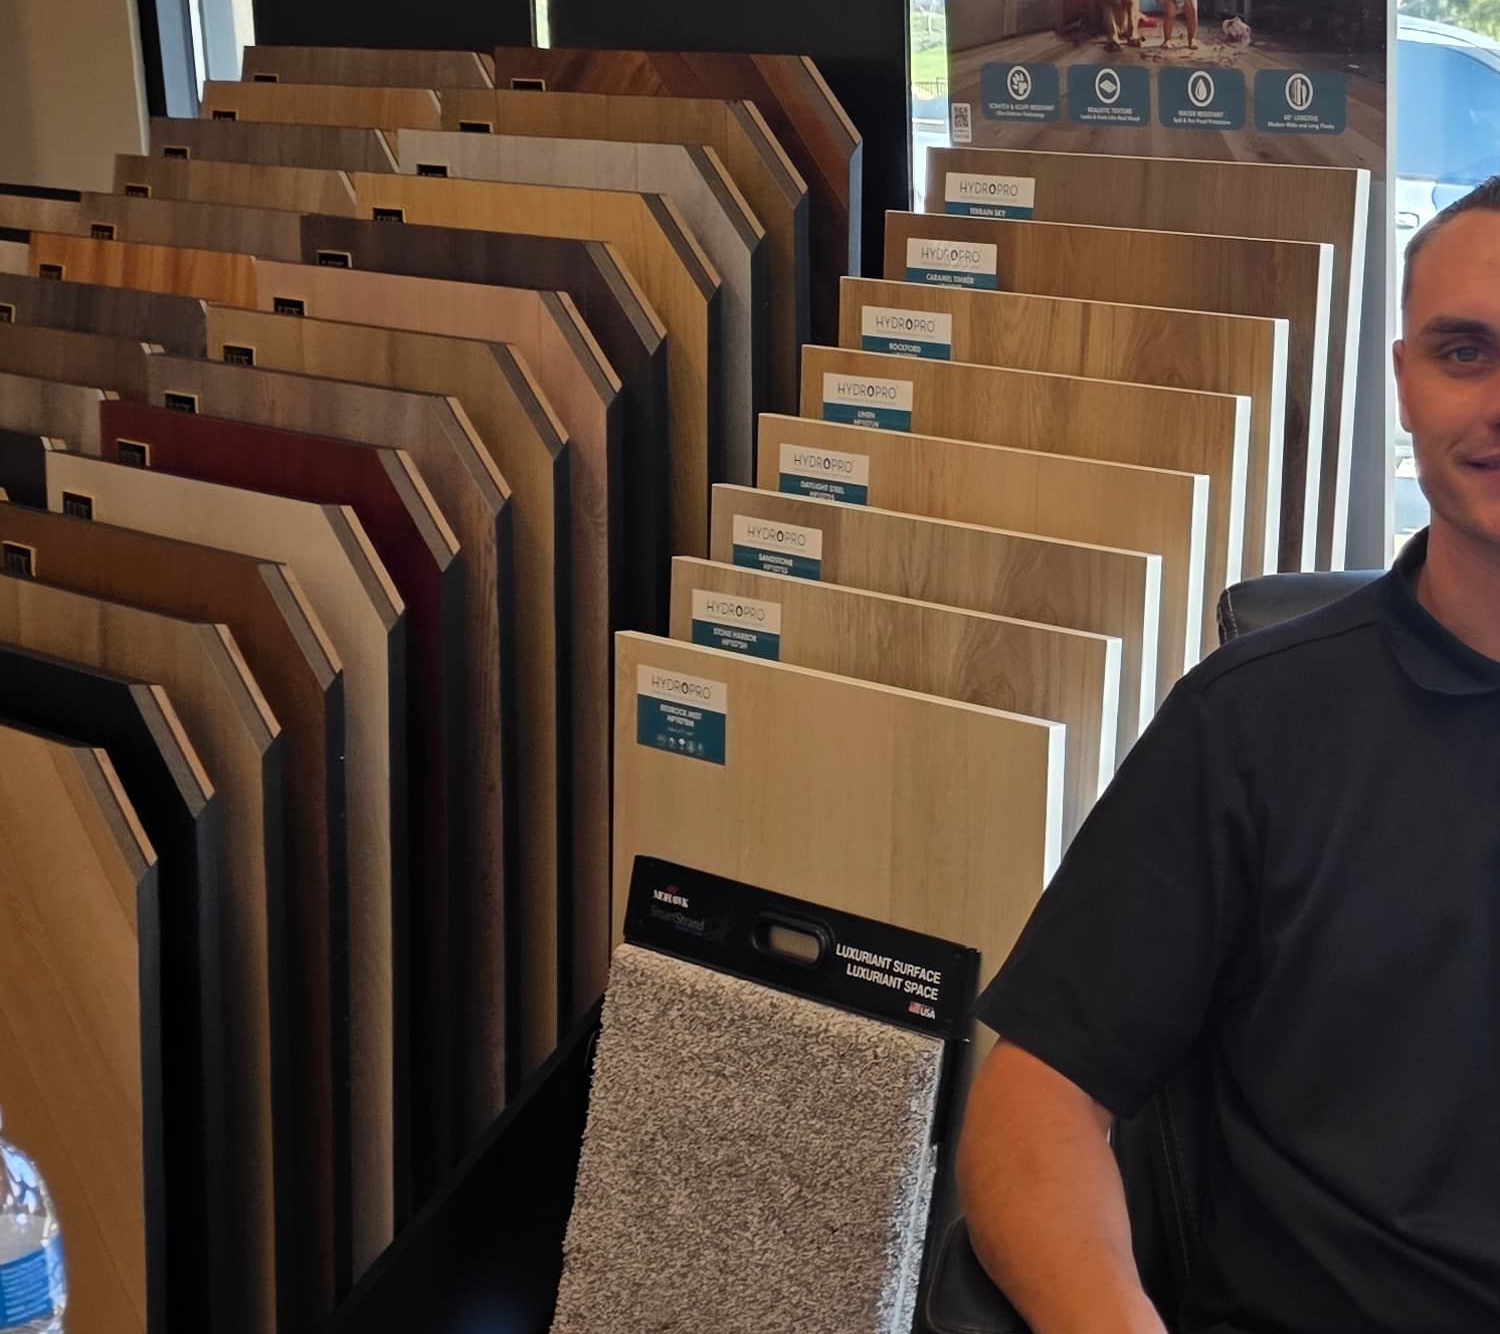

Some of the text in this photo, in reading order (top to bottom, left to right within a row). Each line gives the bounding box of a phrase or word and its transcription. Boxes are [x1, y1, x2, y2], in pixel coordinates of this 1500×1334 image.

[959, 181, 1019, 198] HYDROPRO
[921, 246, 981, 264] HYDROPRO
[875, 314, 937, 333] HYDROPRO
[836, 381, 898, 401] HYDROPRO
[793, 452, 855, 474] HYDROPRO
[746, 524, 807, 547] HYDROPRO
[706, 598, 766, 622] HYDROPRO
[650, 673, 712, 700] HYDROPRO
[835, 942, 942, 985] LUXURIANT SURFACE
[846, 962, 940, 1001] LUXURIANT SPACE
[919, 1004, 936, 1020] USA
